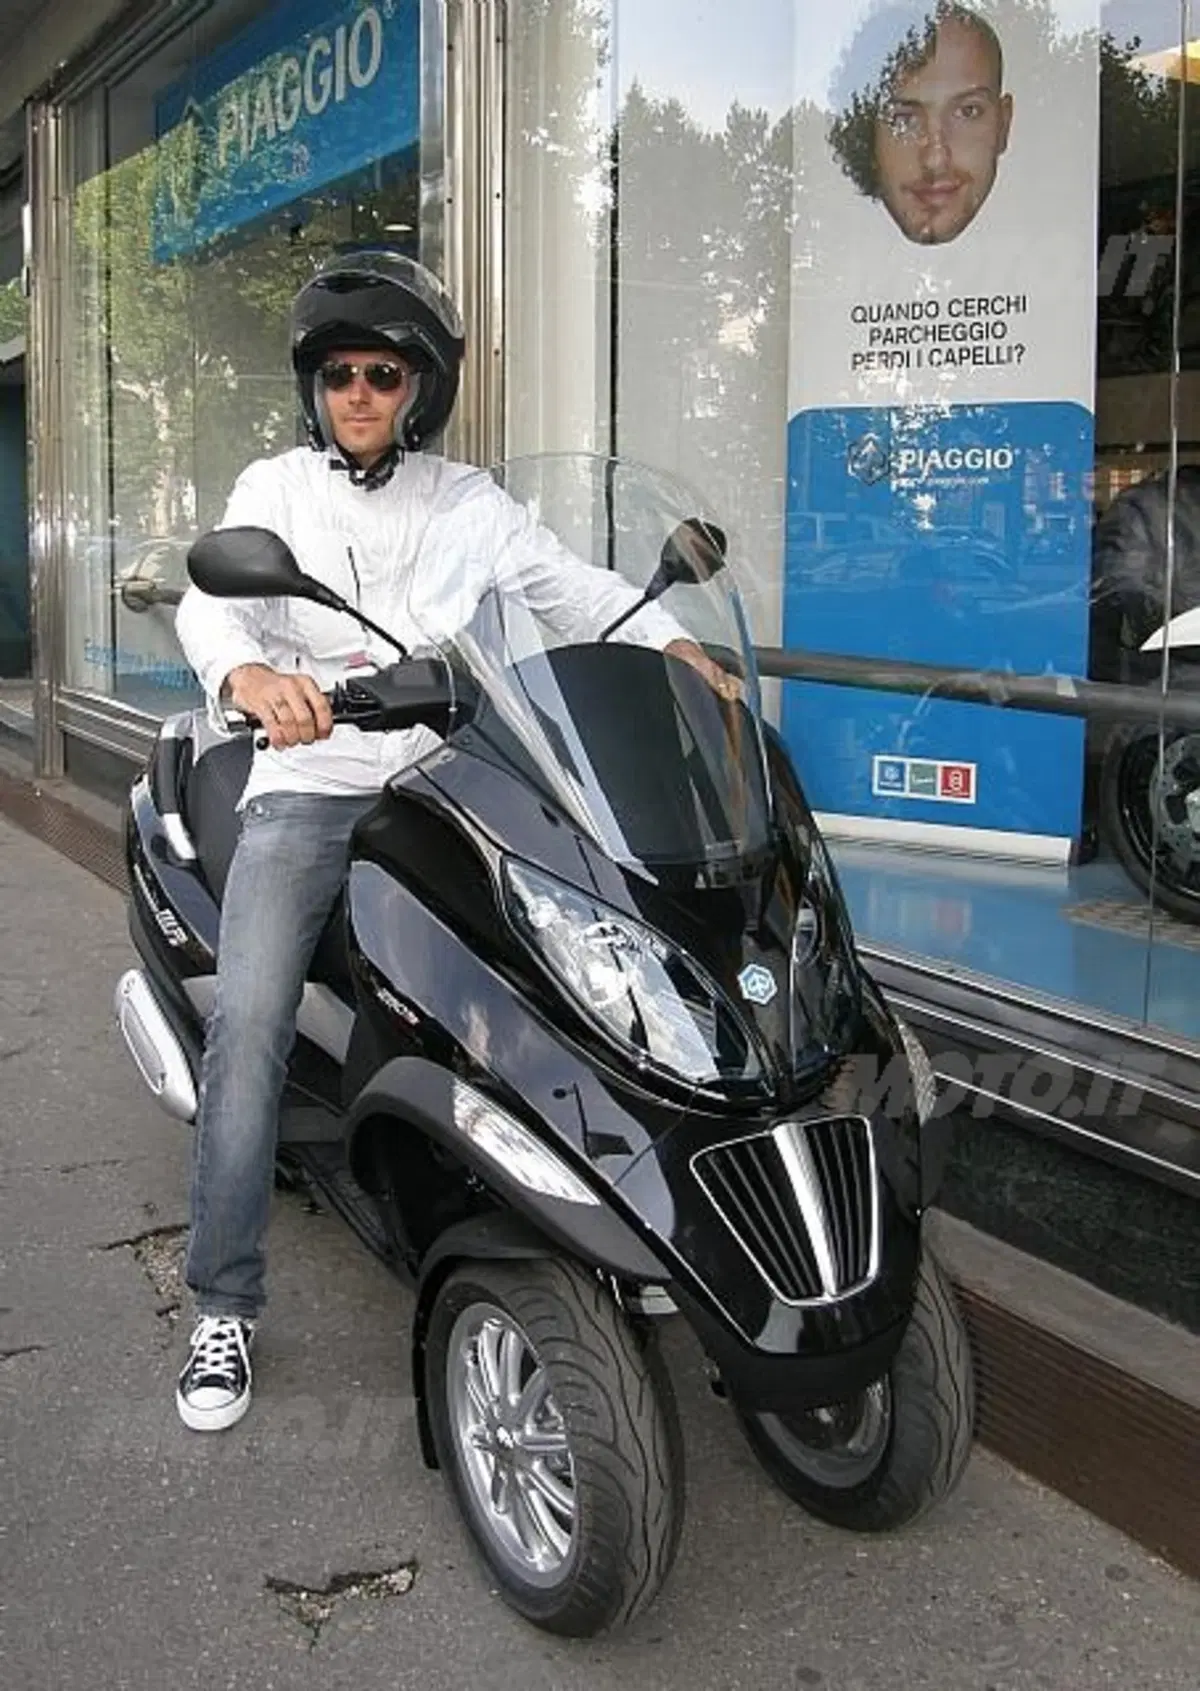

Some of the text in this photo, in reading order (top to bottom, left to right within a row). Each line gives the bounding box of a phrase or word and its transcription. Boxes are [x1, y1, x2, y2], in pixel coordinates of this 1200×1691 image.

[217, 7, 383, 170] PIAGGIO
[851, 295, 1027, 323] QUANDO CERCHI
[869, 320, 1008, 346] PARCHEGGIO
[928, 343, 1026, 367] CAPELLI?
[899, 449, 1013, 473] PIAGGIO
